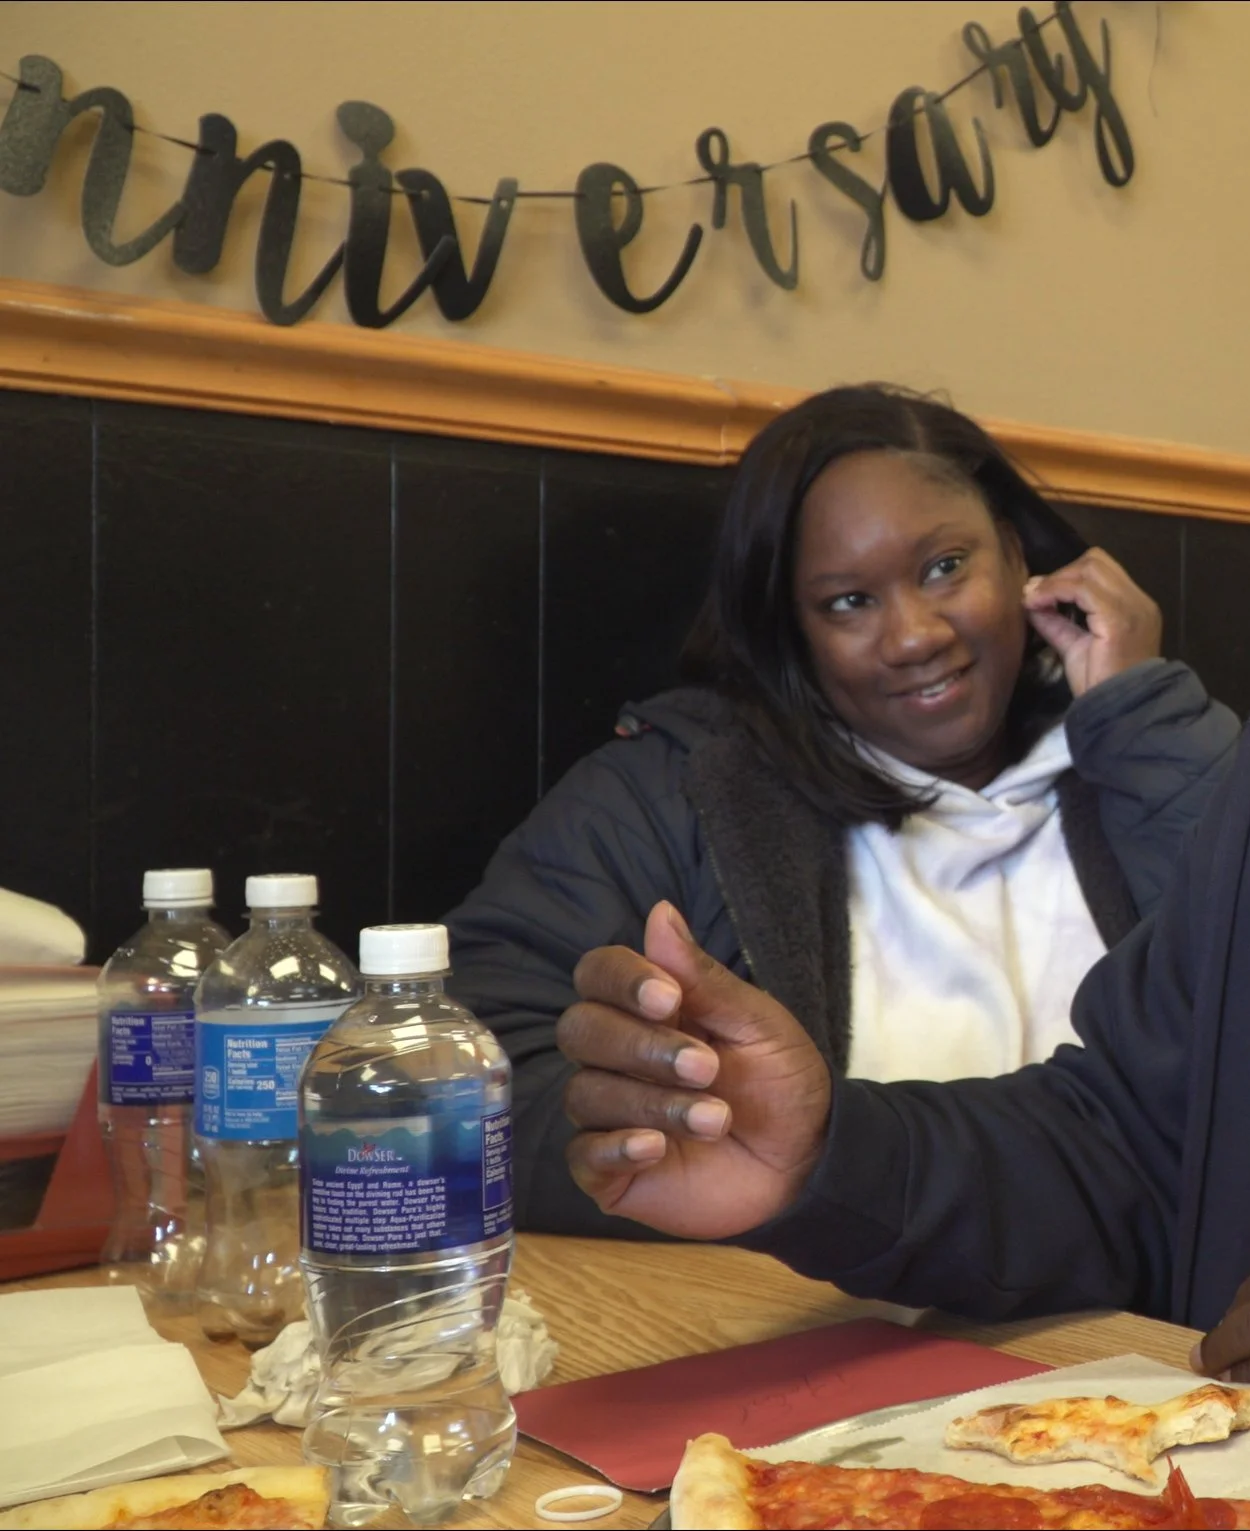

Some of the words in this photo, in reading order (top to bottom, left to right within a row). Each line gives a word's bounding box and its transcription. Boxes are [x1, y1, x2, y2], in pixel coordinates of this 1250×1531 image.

[227, 1039, 268, 1049] Nutrition
[227, 1049, 252, 1059] Facts
[256, 1080, 276, 1091] 250
[359, 1165, 409, 1177] Refreshment
[404, 1197, 428, 1205] Dowser
[373, 1207, 397, 1215] Dowser
[387, 1233, 403, 1241] Pure
